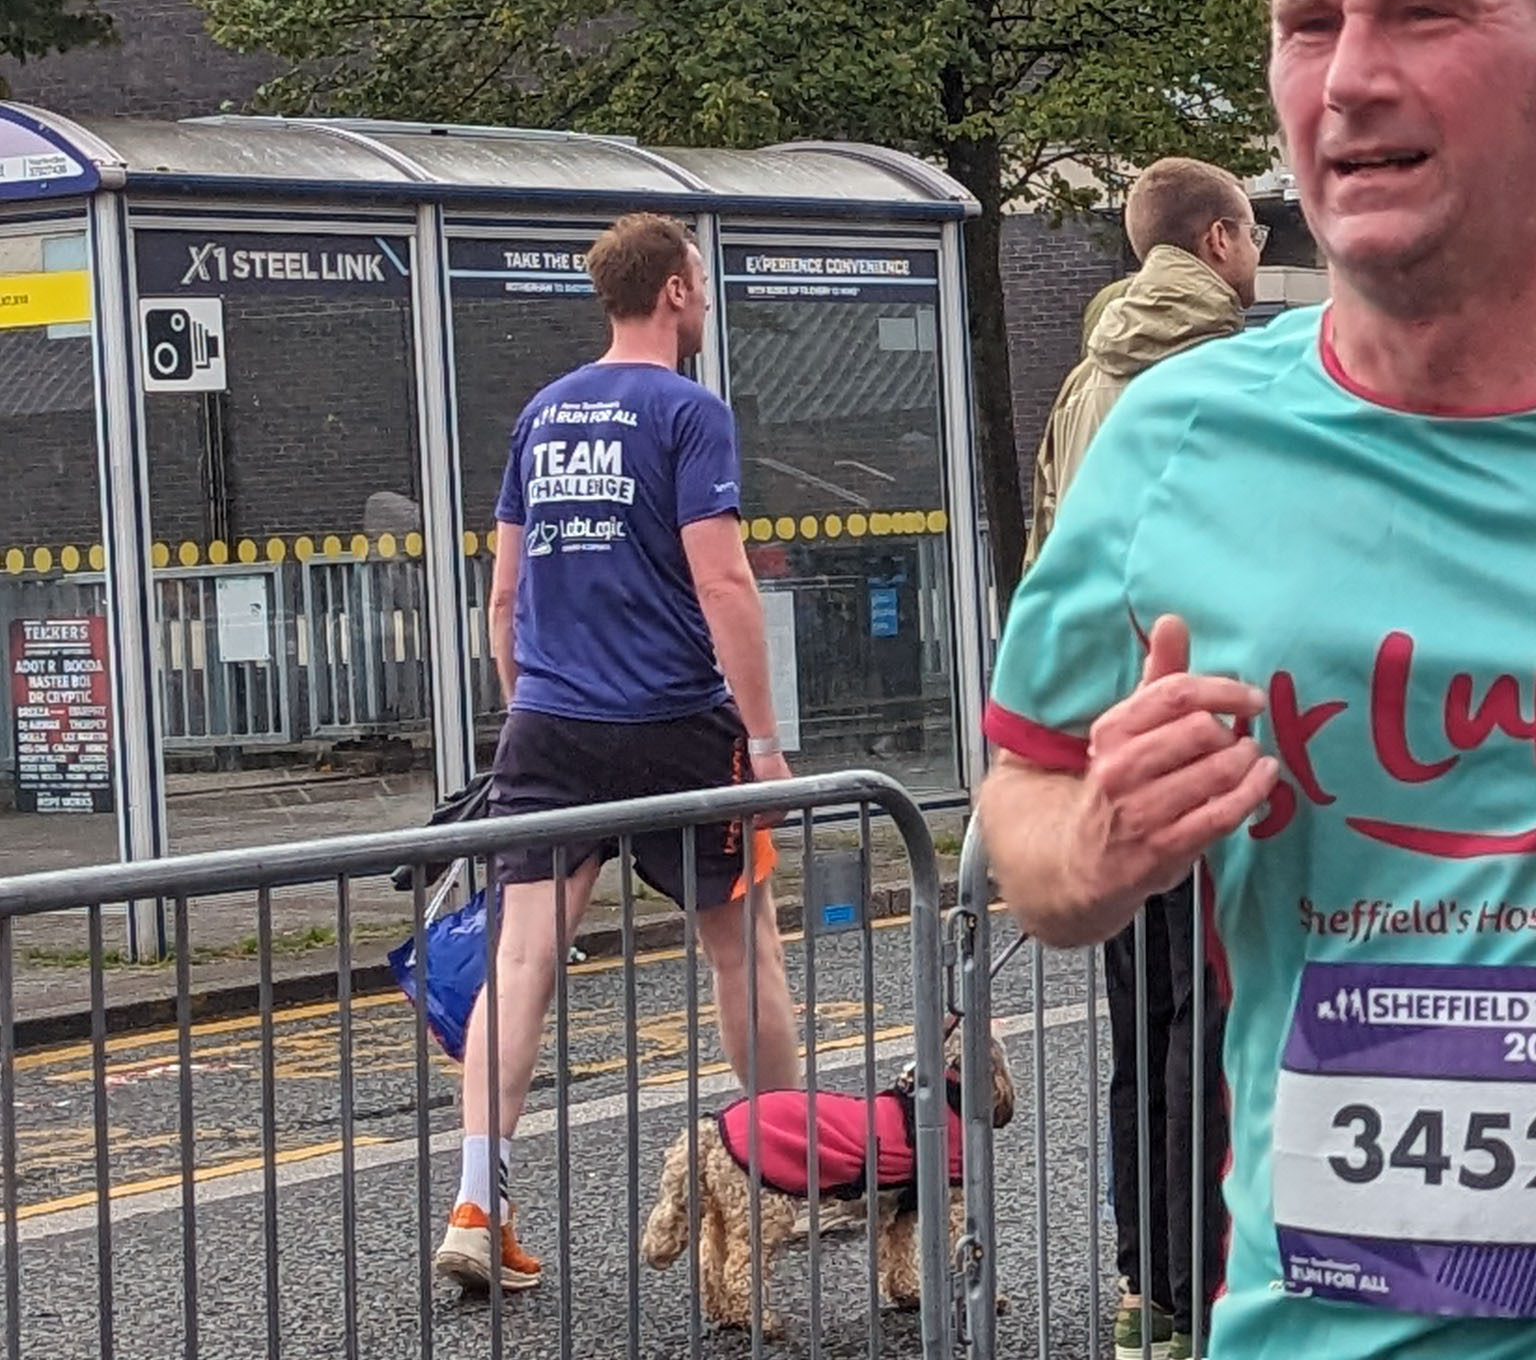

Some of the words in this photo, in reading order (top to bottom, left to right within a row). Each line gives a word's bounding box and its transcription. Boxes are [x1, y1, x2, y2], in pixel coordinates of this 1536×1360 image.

[181, 243, 228, 284] X1
[503, 251, 541, 269] TAKE
[542, 252, 570, 270] THE
[532, 439, 622, 477] TEAM
[531, 478, 631, 501] CHALLENGE
[1372, 992, 1530, 1022] SHEFFIELD
[1324, 1270, 1356, 1290] FOR
[1359, 1274, 1390, 1293] ALL
